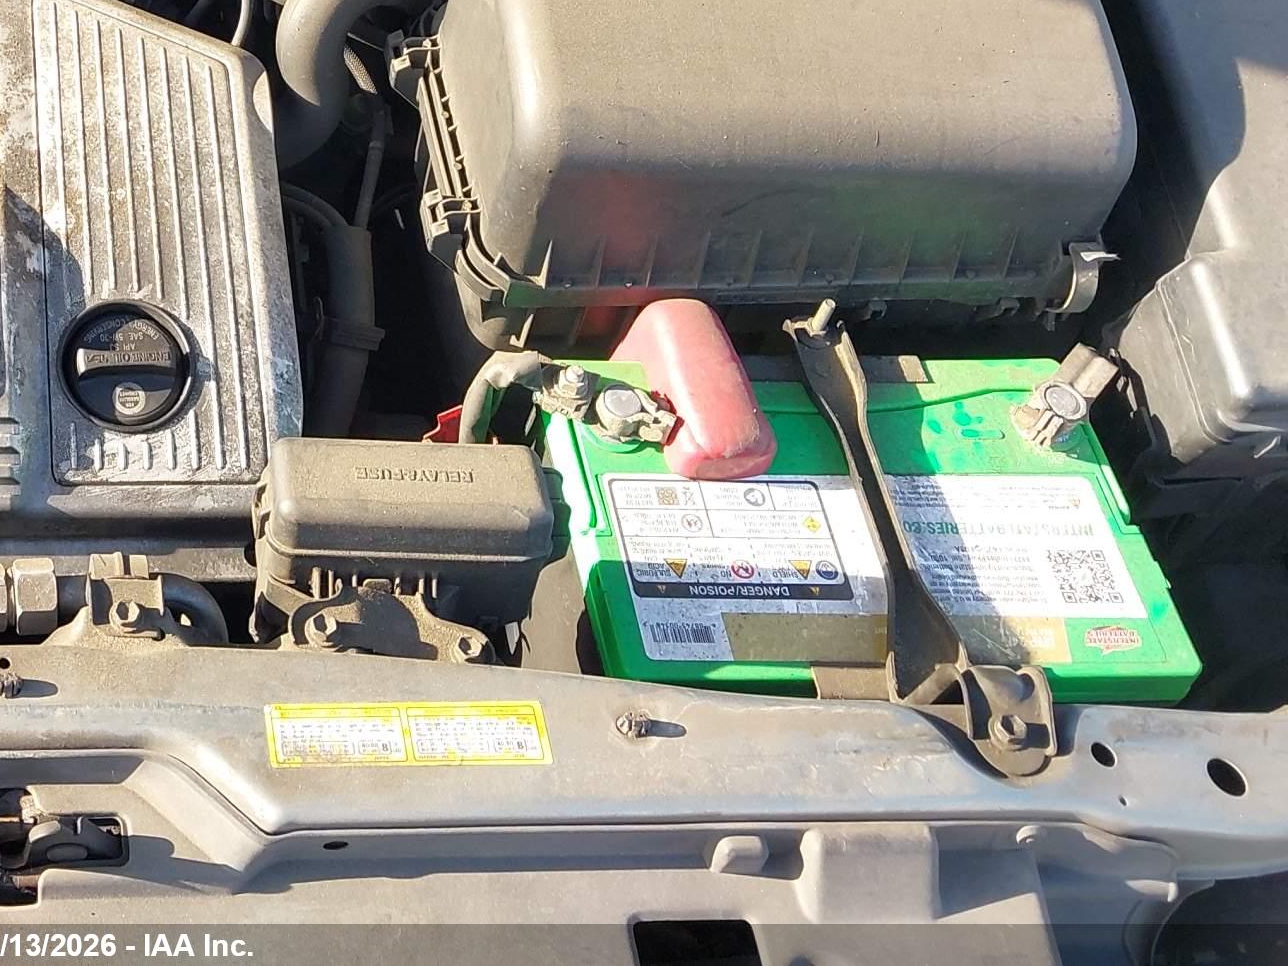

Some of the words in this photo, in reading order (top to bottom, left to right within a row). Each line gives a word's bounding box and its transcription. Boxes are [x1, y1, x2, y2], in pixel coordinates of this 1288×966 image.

[127, 332, 144, 341] SAE
[123, 342, 136, 351] API
[132, 351, 170, 362] ENGINE
[689, 585, 790, 597] DANGER/POISON
